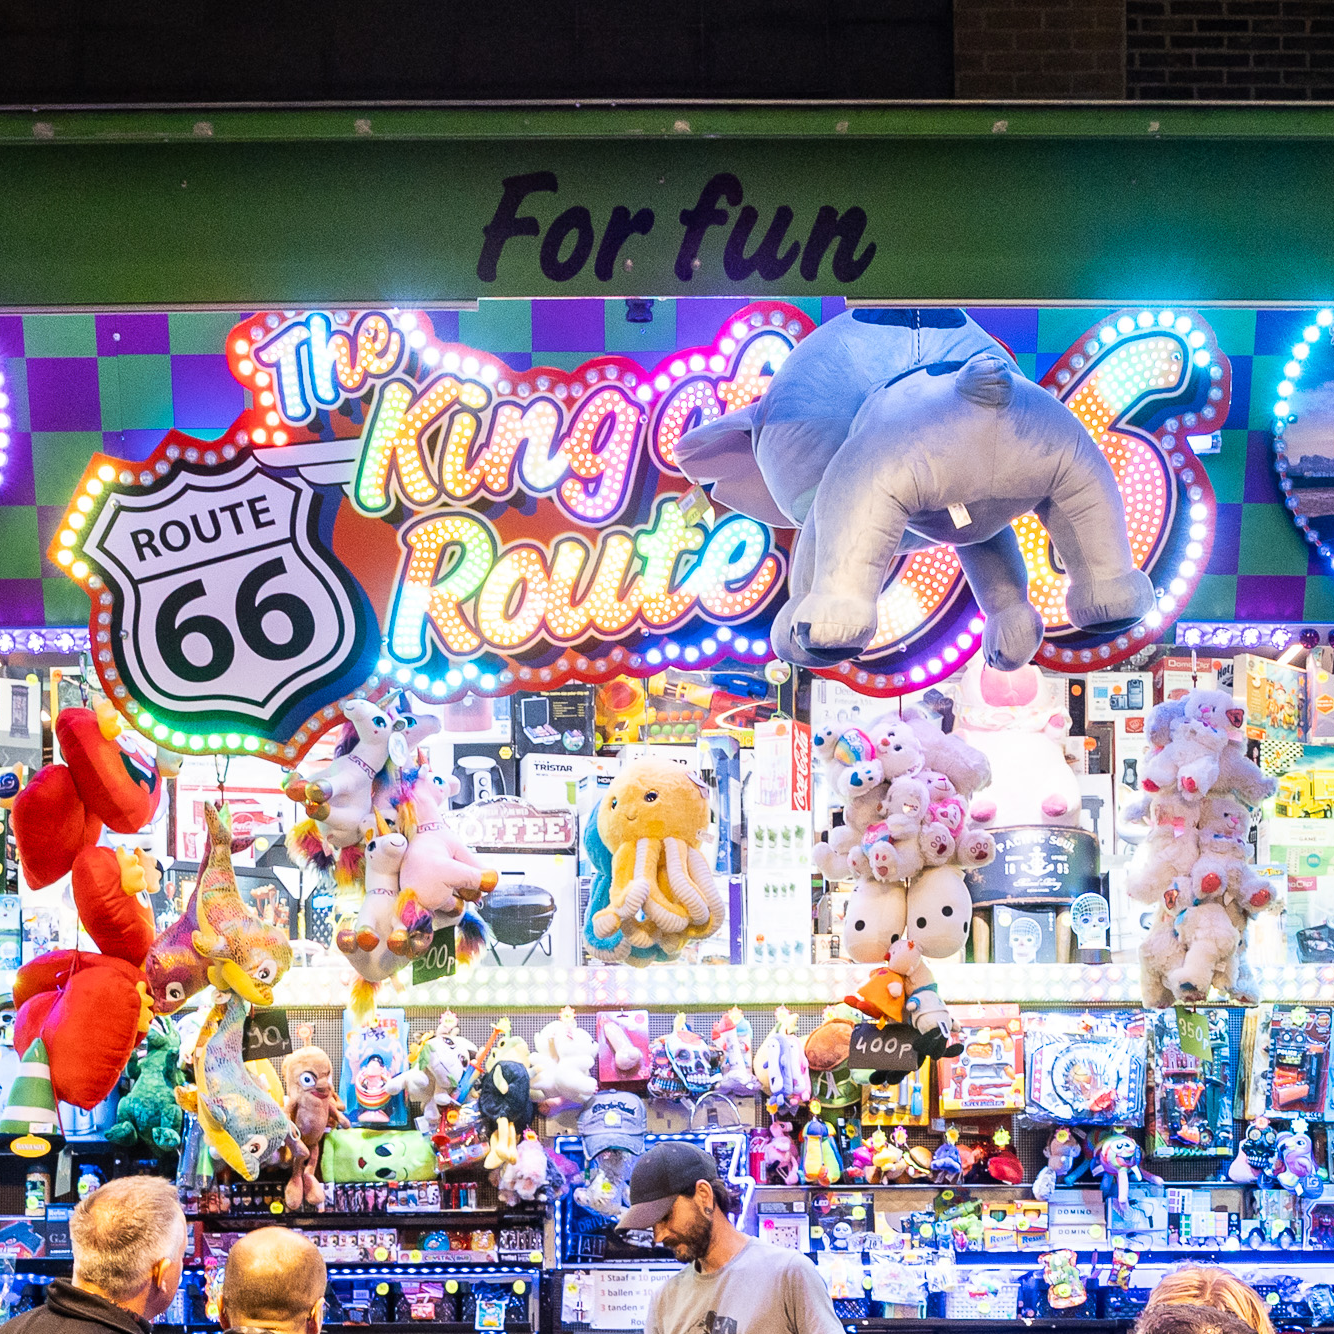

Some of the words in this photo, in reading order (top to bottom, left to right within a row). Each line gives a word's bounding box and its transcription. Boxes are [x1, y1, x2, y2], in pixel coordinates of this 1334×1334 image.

[477, 171, 653, 284] For
[673, 172, 876, 284] fun
[255, 310, 407, 419] The
[357, 376, 644, 522] King
[131, 490, 278, 562] ROUTE
[385, 496, 781, 663] Route
[153, 555, 319, 681] 66
[459, 816, 566, 845] OFFEE
[995, 831, 1046, 854] PACIFIC
[1049, 831, 1077, 853] SOUL
[1057, 1208, 1093, 1216] DOMINO
[608, 1274, 629, 1282] Staaf
[608, 1289, 633, 1297] ballen
[608, 1304, 637, 1312] tanden
